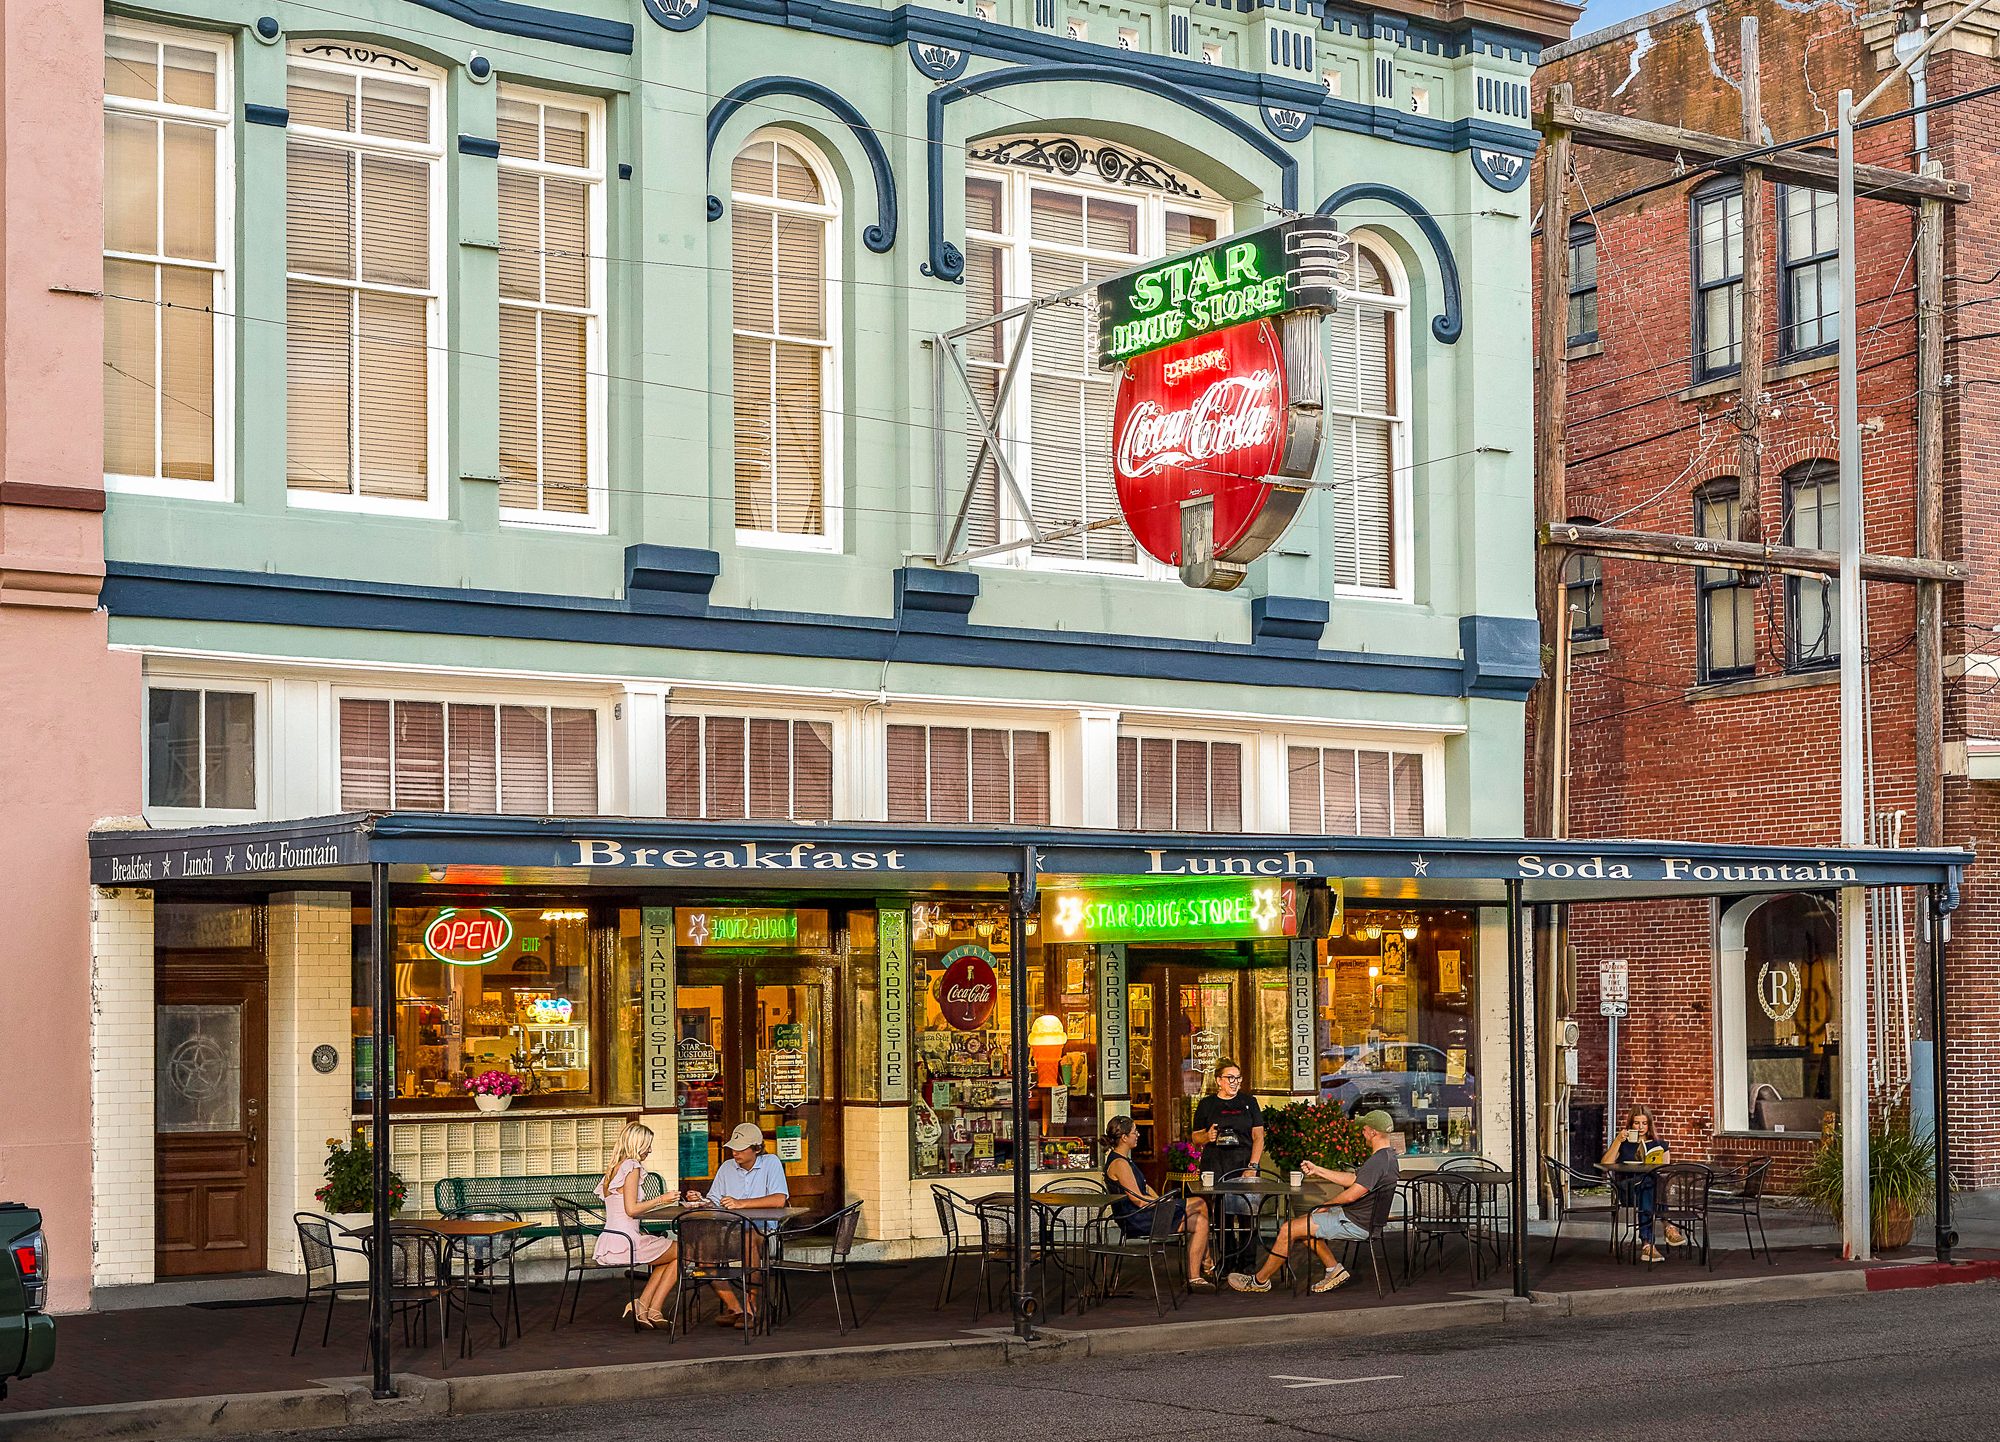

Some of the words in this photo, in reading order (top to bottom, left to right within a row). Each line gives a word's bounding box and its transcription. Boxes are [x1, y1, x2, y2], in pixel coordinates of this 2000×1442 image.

[1130, 242, 1261, 312] STAR
[1107, 307, 1186, 358] DRUG
[1187, 276, 1287, 331] STORE
[112, 854, 152, 881] Breakfast
[182, 849, 213, 876] Lunch
[246, 843, 275, 871] Soda
[279, 837, 338, 868] Fountain
[571, 840, 906, 870] Breakfast
[1144, 850, 1318, 875] Lunch
[1517, 856, 1632, 880] Soda
[1660, 858, 1859, 882] Fountain
[1085, 902, 1129, 928] STAR
[1135, 900, 1181, 927] DRUG
[1188, 897, 1248, 925] STORE
[430, 920, 504, 950] OPEN
[522, 937, 539, 952] EXIT
[650, 924, 666, 972] STAR
[886, 924, 901, 972] STAR
[947, 947, 993, 963] ALWAYS
[1296, 941, 1308, 972] TAR
[651, 977, 667, 1026] DRUG
[886, 977, 901, 1024] DRUG
[947, 984, 993, 1003] Coca-Cola
[1107, 976, 1121, 1020] DRUG
[1296, 977, 1309, 1019] DRUG
[1769, 970, 1791, 1006] R
[651, 1032, 667, 1092] STORE
[678, 1050, 714, 1058] UGSTORE
[681, 1043, 700, 1051] STAR
[777, 1040, 800, 1048] OPEN
[886, 1028, 902, 1086] STORE
[1107, 1024, 1121, 1081] STORE
[1297, 1023, 1310, 1078] STORE
